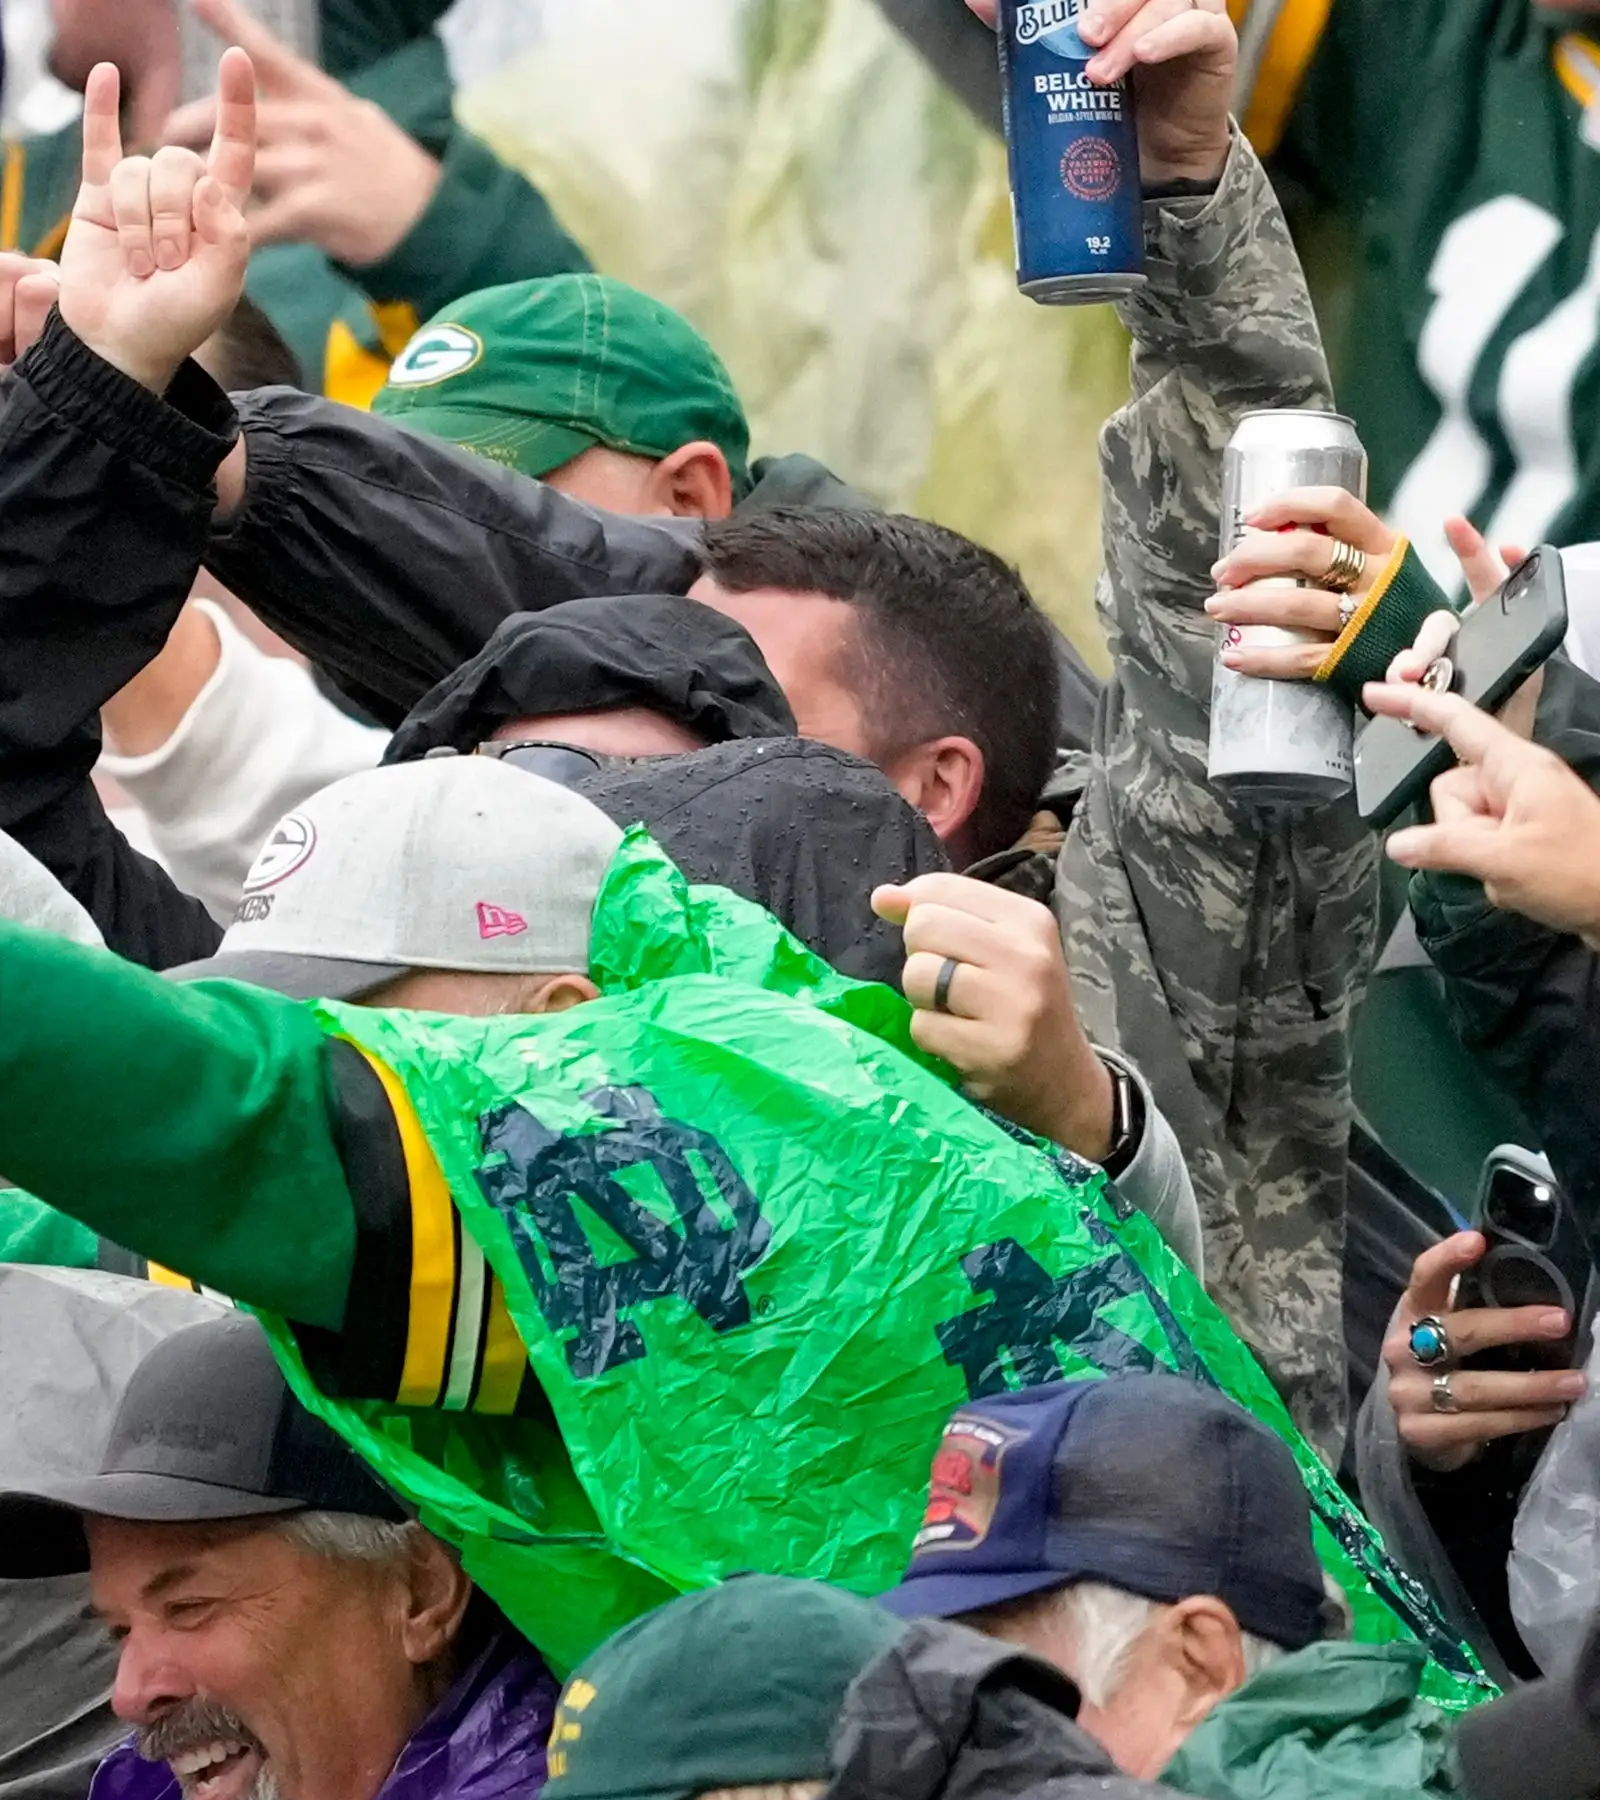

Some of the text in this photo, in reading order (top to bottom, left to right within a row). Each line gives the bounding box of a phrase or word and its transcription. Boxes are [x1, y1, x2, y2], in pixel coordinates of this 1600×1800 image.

[1018, 0, 1078, 39] BLUE
[1034, 72, 1125, 93] BELGN
[1046, 91, 1120, 111] WHITE
[1085, 236, 1111, 249] 19.2
